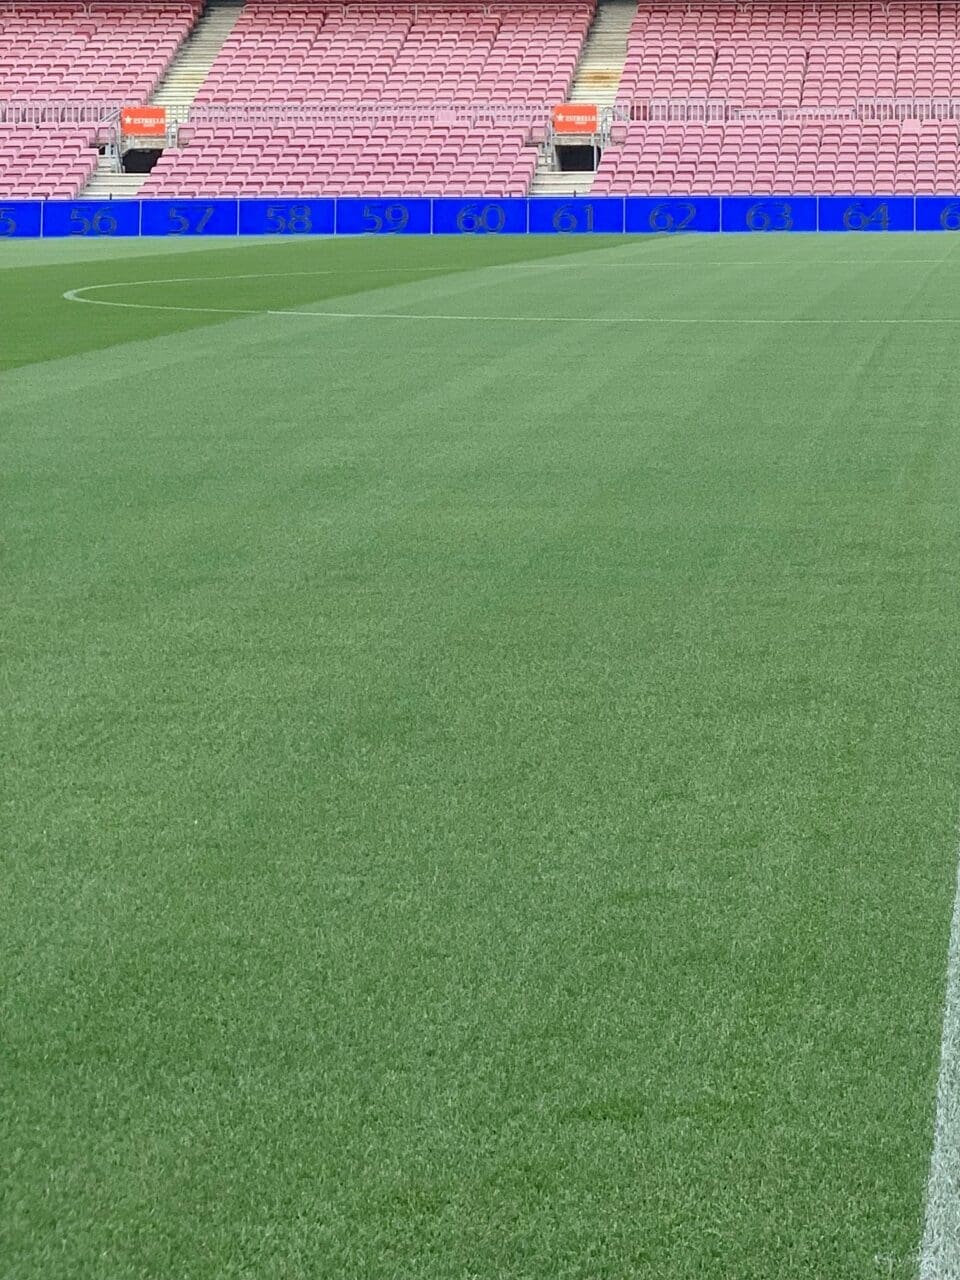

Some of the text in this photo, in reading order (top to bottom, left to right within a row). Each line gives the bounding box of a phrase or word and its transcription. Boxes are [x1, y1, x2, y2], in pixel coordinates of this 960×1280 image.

[70, 206, 117, 236] 56
[168, 206, 214, 235] 57
[264, 205, 312, 234] 58
[362, 204, 409, 234] 59
[457, 204, 505, 233] 60
[553, 204, 593, 233] 61
[649, 203, 698, 232] 62
[746, 203, 793, 232] 63
[843, 203, 890, 232] 64
